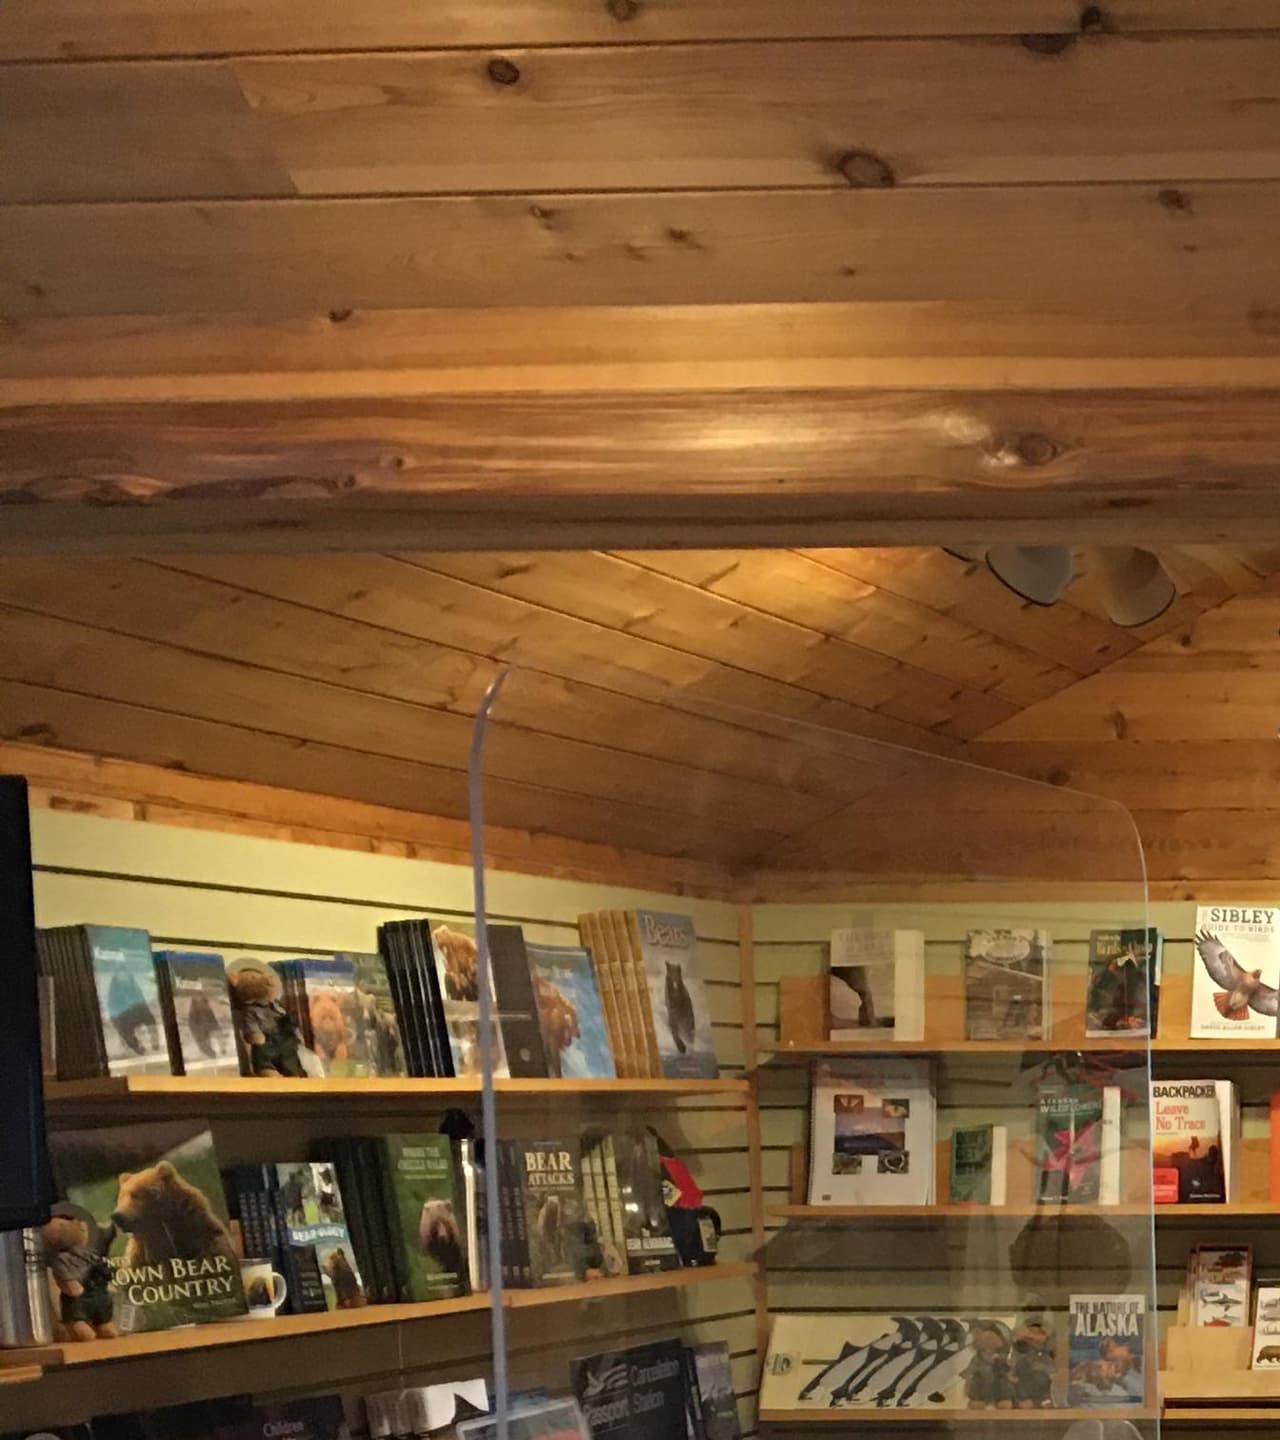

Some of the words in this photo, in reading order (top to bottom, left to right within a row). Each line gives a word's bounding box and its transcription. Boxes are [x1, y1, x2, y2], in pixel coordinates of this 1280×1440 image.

[1210, 908, 1275, 924] SIBLEY
[643, 914, 689, 949] Bears
[1153, 1084, 1216, 1099] BACKPACKER
[1155, 1102, 1190, 1116] Leave
[1155, 1116, 1172, 1131] No
[1174, 1116, 1206, 1131] Trace
[524, 1152, 573, 1171] BEAR
[527, 1172, 575, 1186] ATTACKS
[110, 1264, 164, 1287] OWN
[170, 1255, 231, 1279] BEAR
[127, 1275, 235, 1306] COUNTRY
[1075, 1313, 1139, 1337] ALASKA
